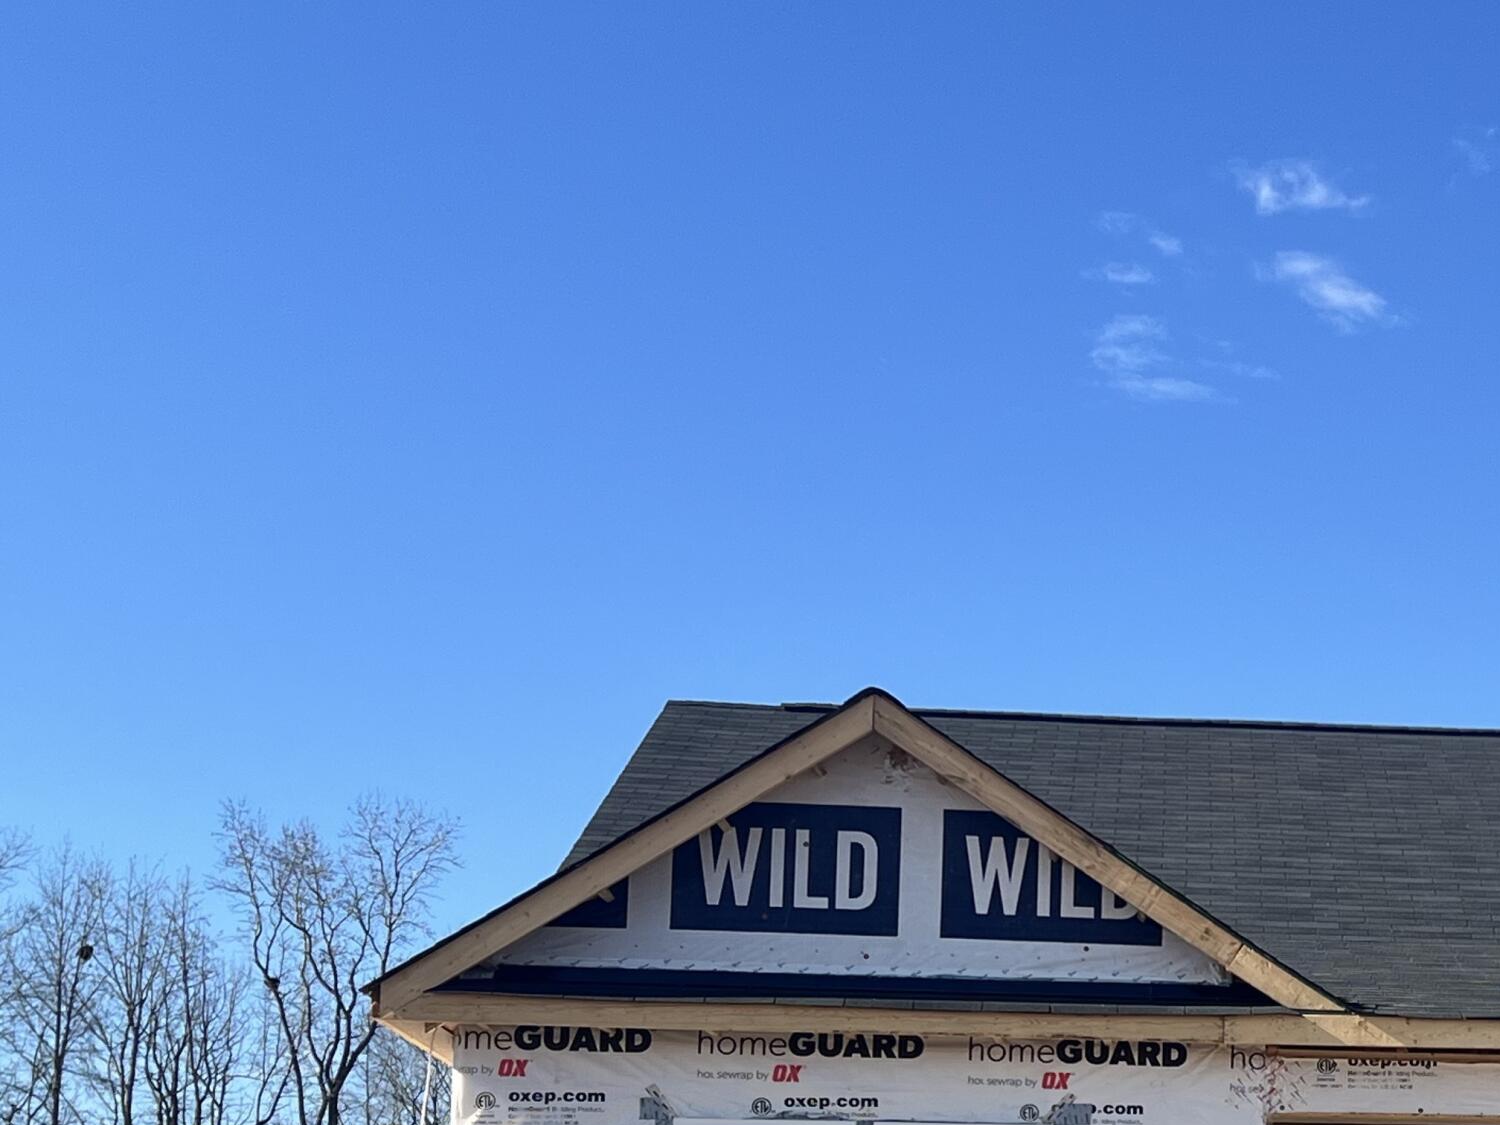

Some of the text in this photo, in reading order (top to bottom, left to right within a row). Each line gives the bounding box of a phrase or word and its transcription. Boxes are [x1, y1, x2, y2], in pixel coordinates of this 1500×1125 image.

[700, 827, 878, 910] WILD
[458, 1025, 652, 1053] meGUARD
[698, 1030, 924, 1059] homeGUARD
[968, 1037, 1188, 1067] homeGUARD
[498, 1059, 529, 1077] OX
[756, 1069, 769, 1082] by
[772, 1064, 802, 1082] OX
[1024, 1076, 1038, 1088] by
[1041, 1071, 1071, 1090] OX
[508, 1091, 606, 1105] oxep.com
[784, 1096, 879, 1110] oxep.com
